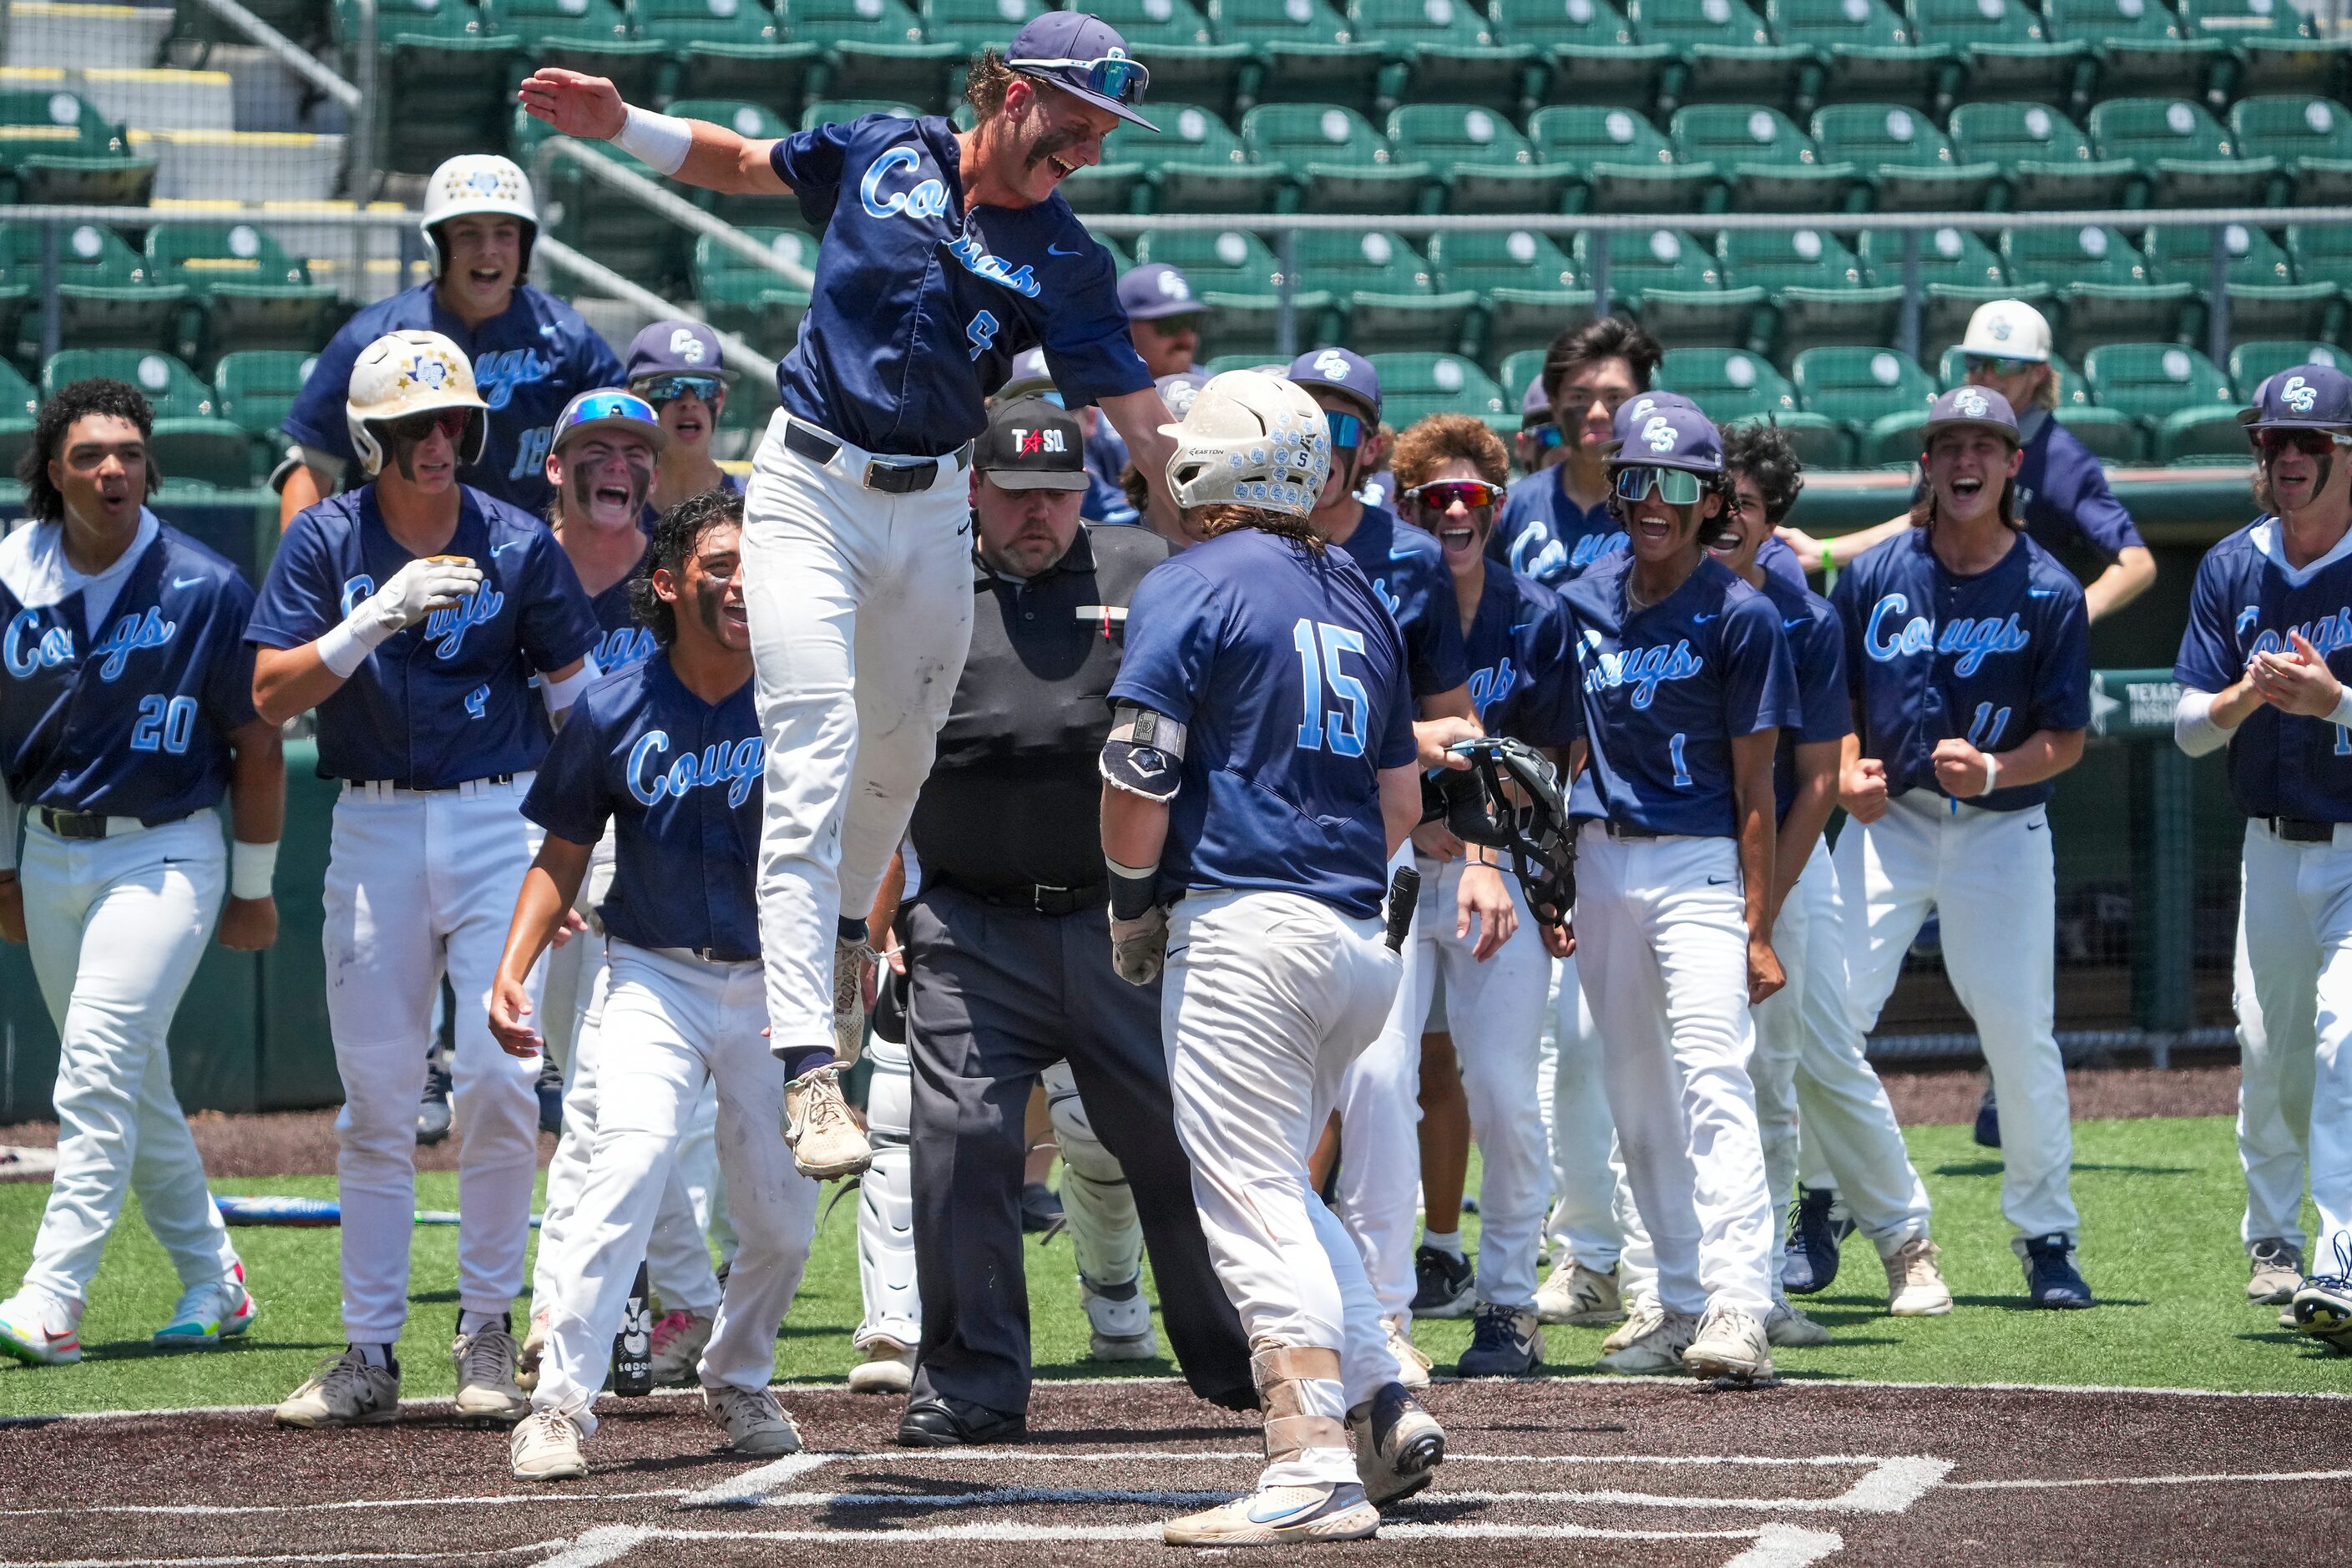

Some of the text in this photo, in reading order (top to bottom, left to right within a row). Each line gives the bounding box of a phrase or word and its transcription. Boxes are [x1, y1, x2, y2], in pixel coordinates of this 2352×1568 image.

[670, 328, 706, 363] CS
[1313, 350, 1351, 381] CS
[475, 347, 551, 411] ugs
[1954, 388, 1989, 417] CS
[2280, 376, 2317, 412] CS
[1641, 417, 1678, 453] CS
[1864, 593, 2031, 678] Cougs
[1293, 618, 1368, 757] 15
[130, 694, 198, 755] 20
[1968, 701, 2011, 748] 11
[626, 729, 765, 809] Coug
[1669, 732, 1693, 787] 1
